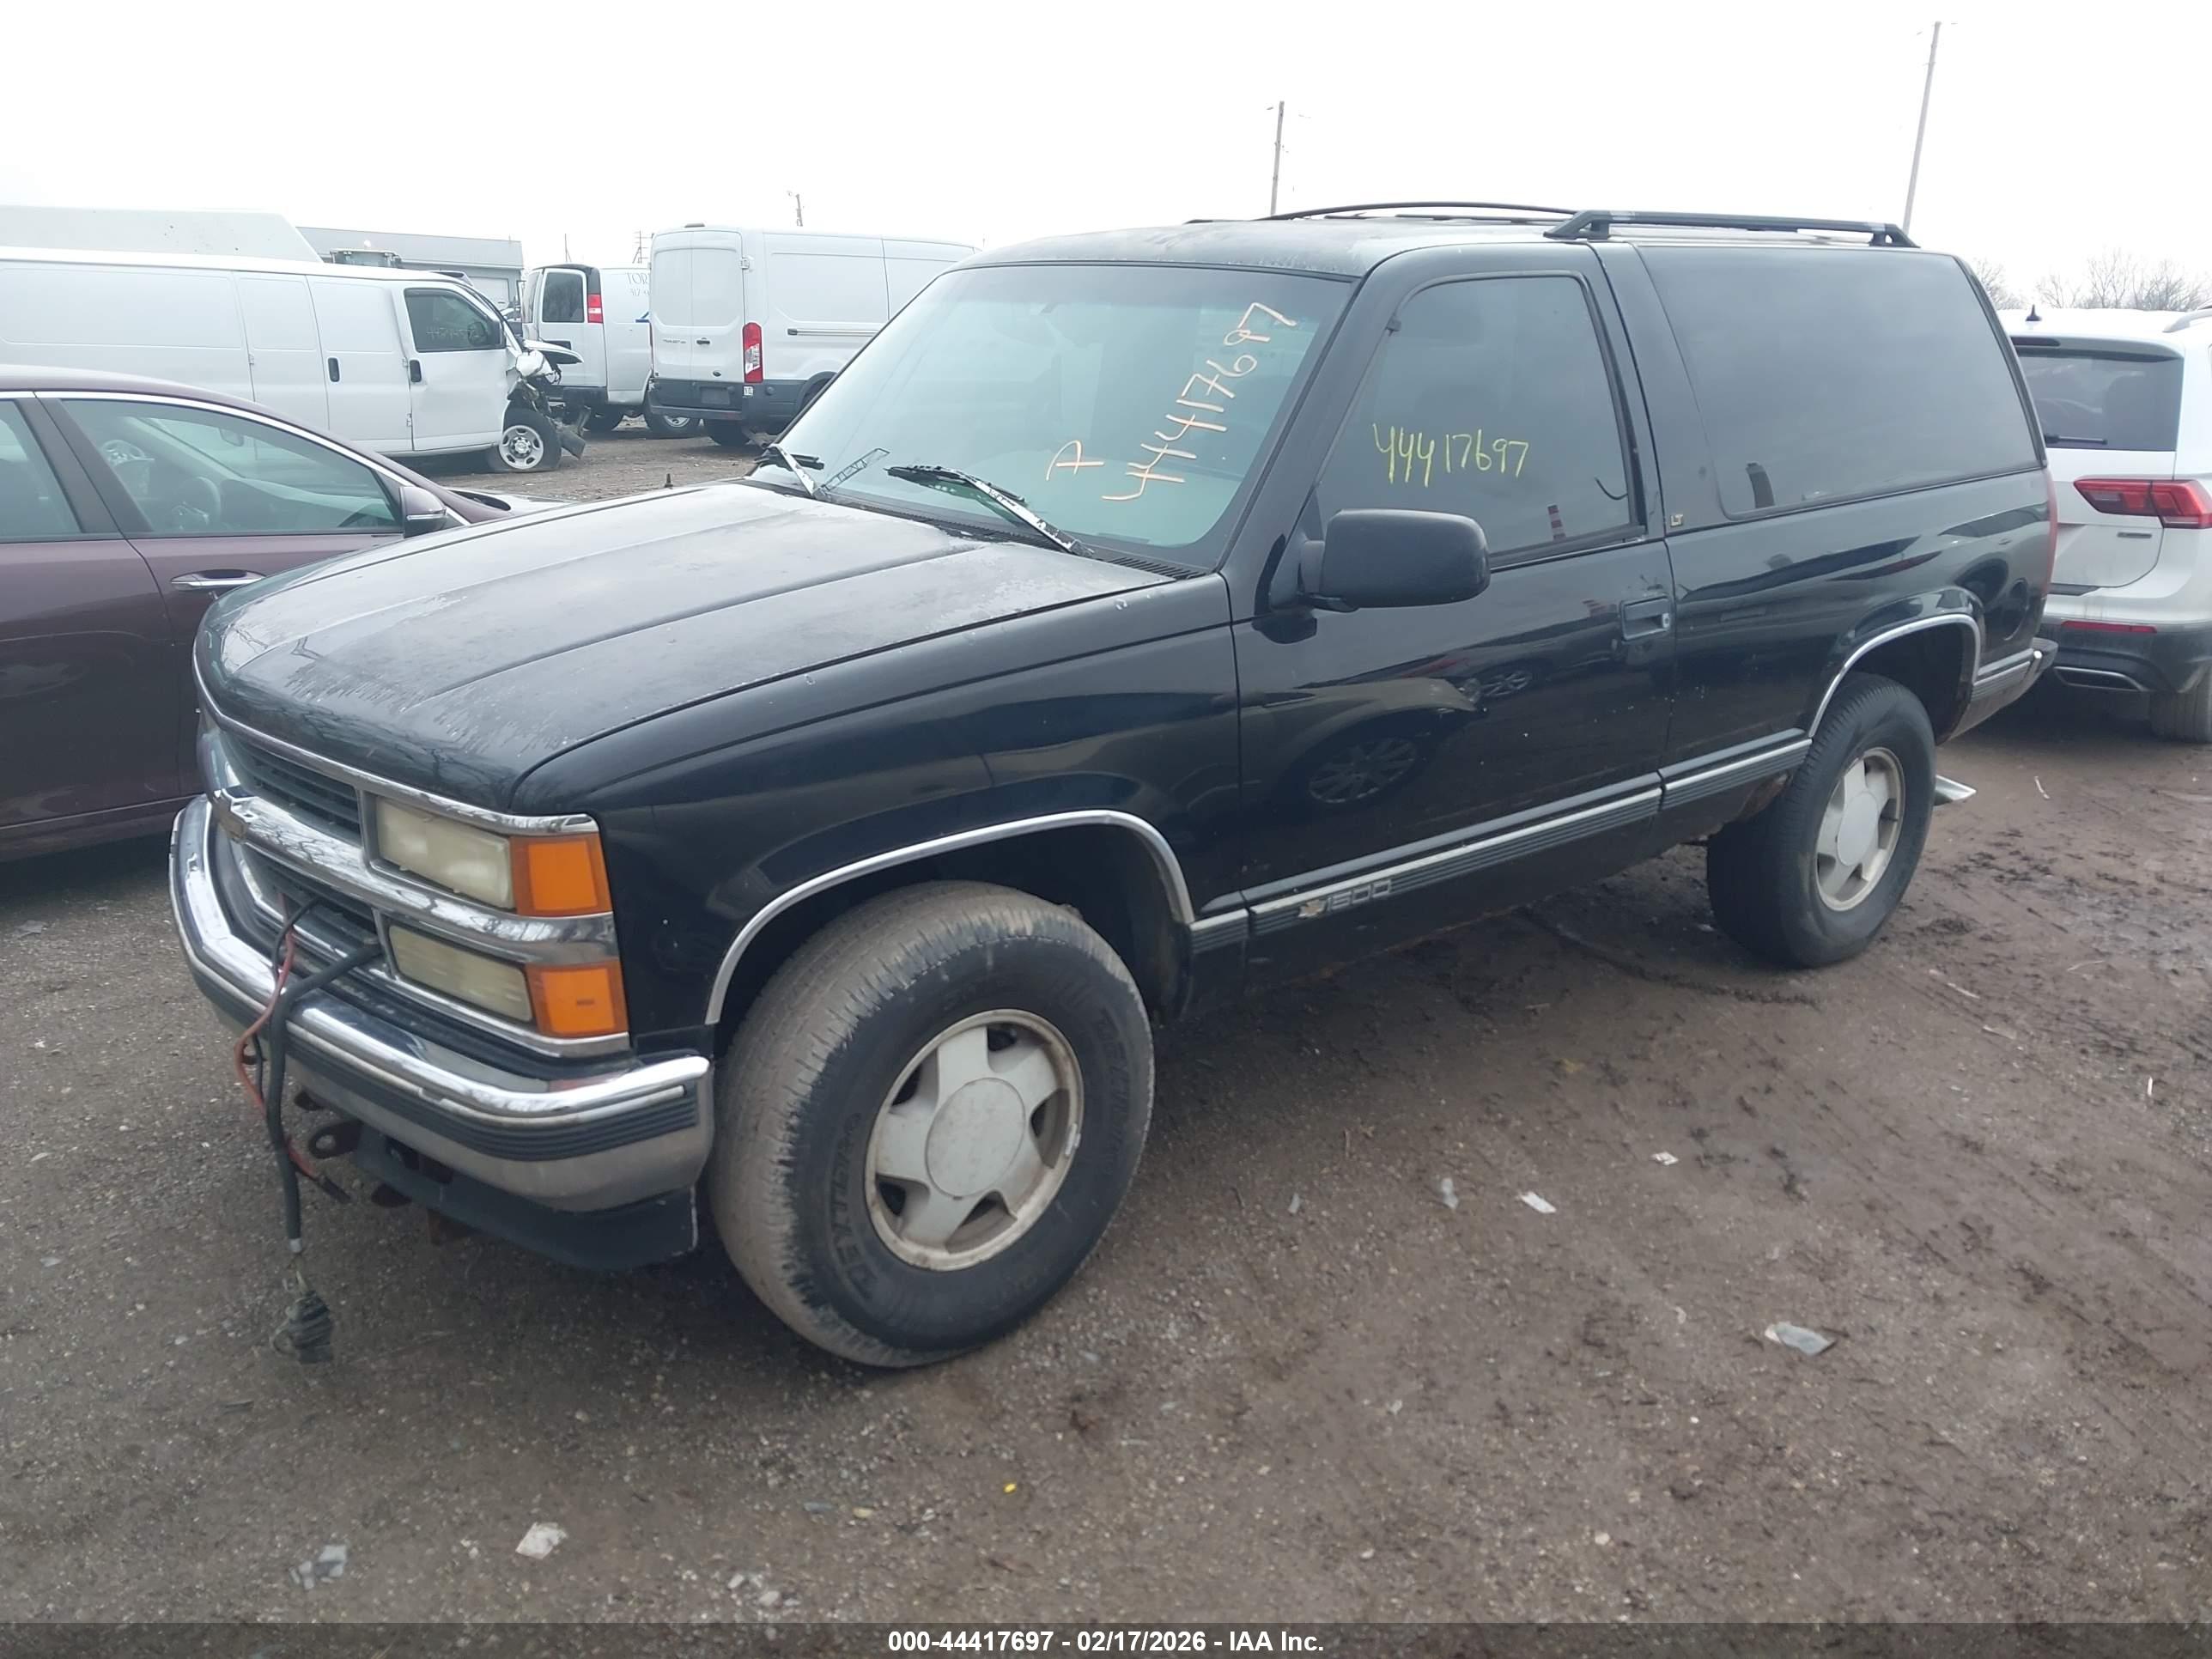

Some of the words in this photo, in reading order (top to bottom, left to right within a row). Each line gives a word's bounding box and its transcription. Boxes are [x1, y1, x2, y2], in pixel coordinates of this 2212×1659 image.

[1101, 301, 1297, 501] 44417697
[1373, 422, 1528, 488] 44417697
[1327, 878, 1391, 912] 1500
